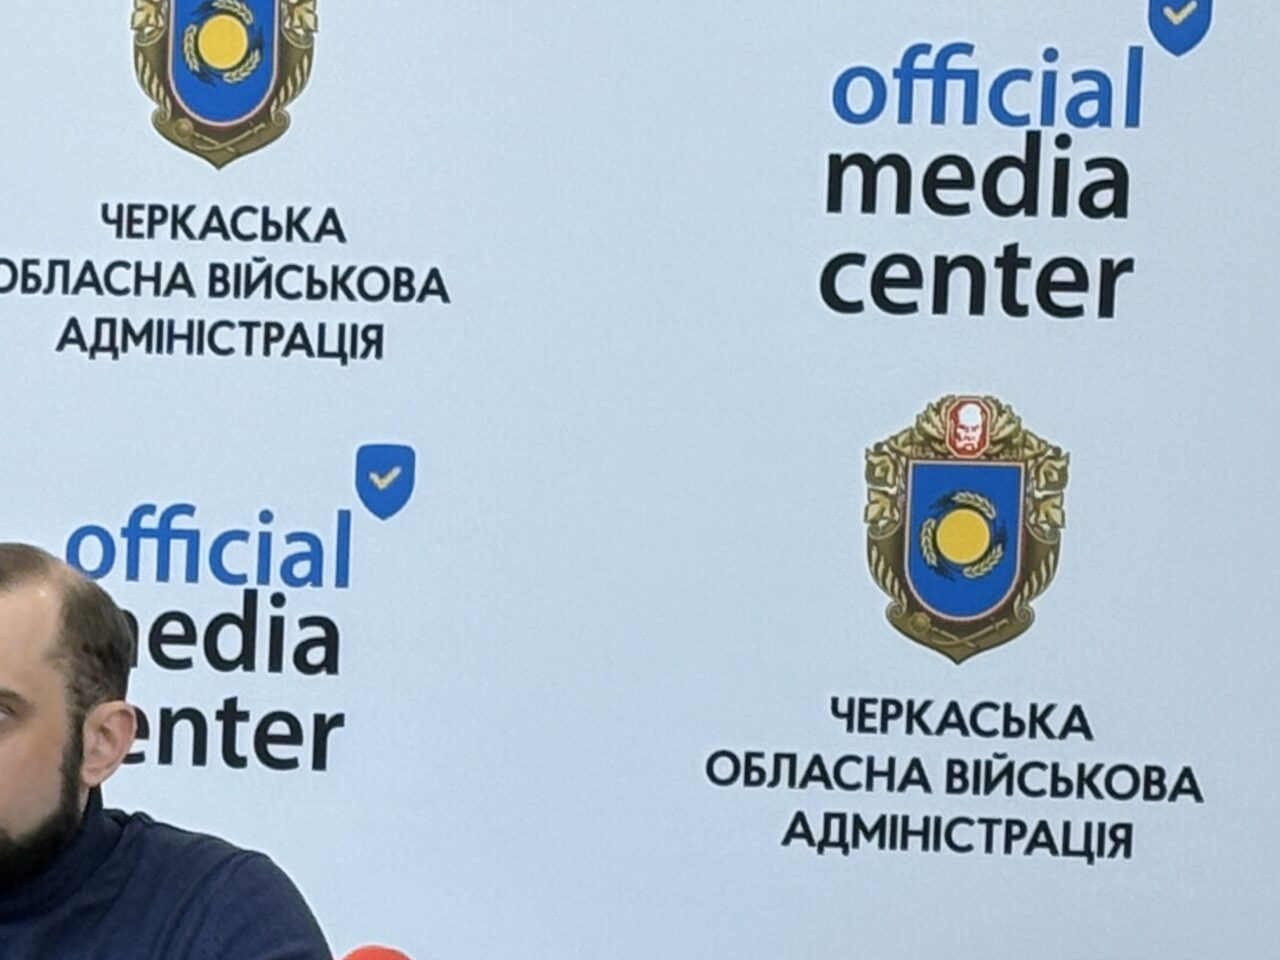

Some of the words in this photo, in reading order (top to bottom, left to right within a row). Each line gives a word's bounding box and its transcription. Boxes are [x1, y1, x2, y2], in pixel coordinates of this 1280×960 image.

[832, 42, 1144, 129] official
[826, 130, 1130, 219] media
[101, 202, 347, 243] ЧЕРКАСЬКА
[208, 257, 451, 304] ВІЙСЬКОВА
[819, 242, 1135, 318] center
[55, 317, 384, 366] АДМІНІСТРАЦІЯ
[66, 503, 352, 588] official
[129, 589, 340, 675] edia
[122, 696, 345, 771] nter
[830, 696, 1094, 741] ЧЕРКАСЬКА
[705, 750, 932, 794] ОБЛАСНА
[945, 752, 1204, 803] ВІЙСЬКОВА
[781, 811, 1133, 865] АДМІНІСТРАЦІЯ
